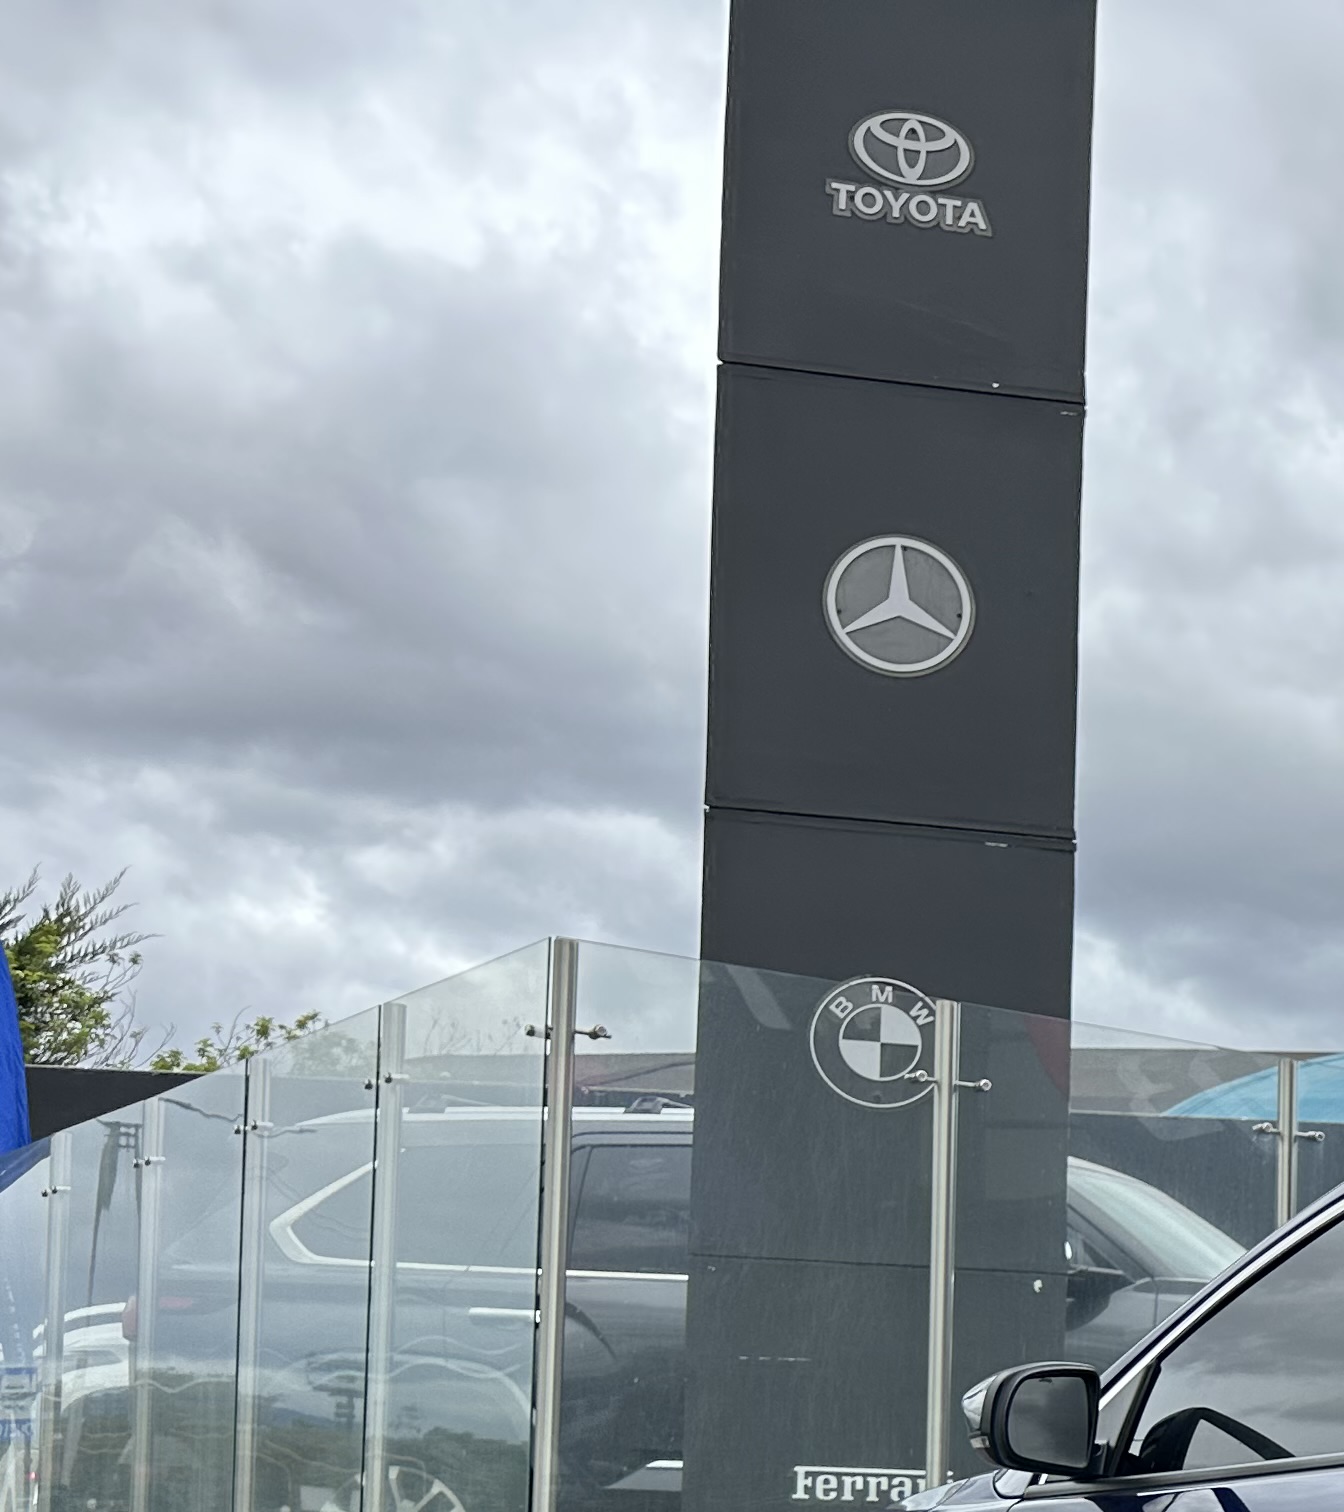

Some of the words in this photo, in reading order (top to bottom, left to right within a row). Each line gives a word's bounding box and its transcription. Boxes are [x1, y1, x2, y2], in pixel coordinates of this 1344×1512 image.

[829, 182, 987, 230] TOYOTA
[829, 985, 935, 1026] BMW
[792, 1465, 954, 1502] Ferra
